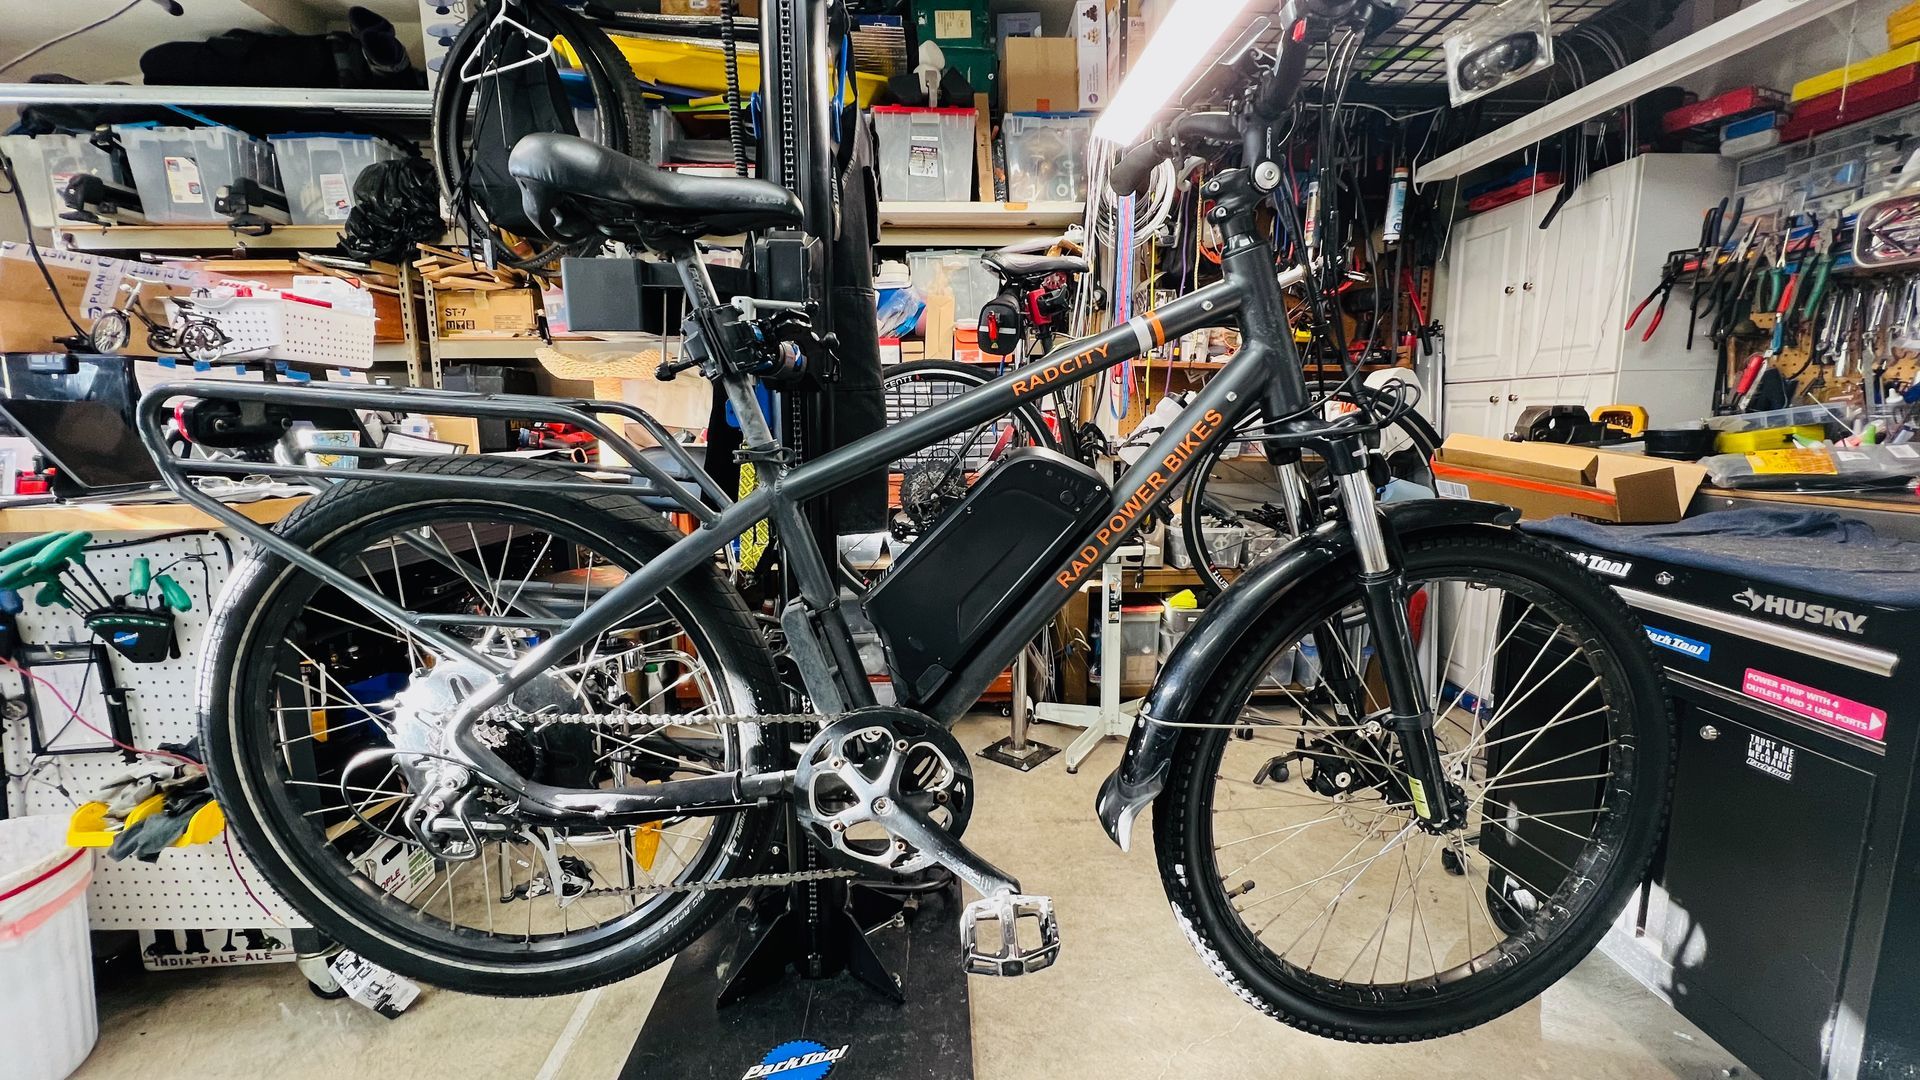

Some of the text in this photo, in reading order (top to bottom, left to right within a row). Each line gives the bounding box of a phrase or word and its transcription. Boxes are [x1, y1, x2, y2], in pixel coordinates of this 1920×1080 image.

[445, 308, 467, 316] ST-7
[1012, 343, 1110, 397] RADCITY
[1056, 408, 1224, 589] RAD POWER BIKES
[1764, 594, 1868, 634] HUSKY
[1748, 673, 1839, 709] POWER STRIP WITH 4
[1746, 683, 1782, 701] OUTLETS
[1783, 695, 1805, 708] AND
[1814, 706, 1834, 718] USB
[1835, 713, 1868, 730] PORTS
[1750, 733, 1795, 756] TRUST ME
[1764, 748, 1771, 758] A
[1773, 751, 1793, 766] BIKE
[1748, 749, 1792, 773] MECHANIC
[153, 952, 273, 967] INDIA PALE ALE
